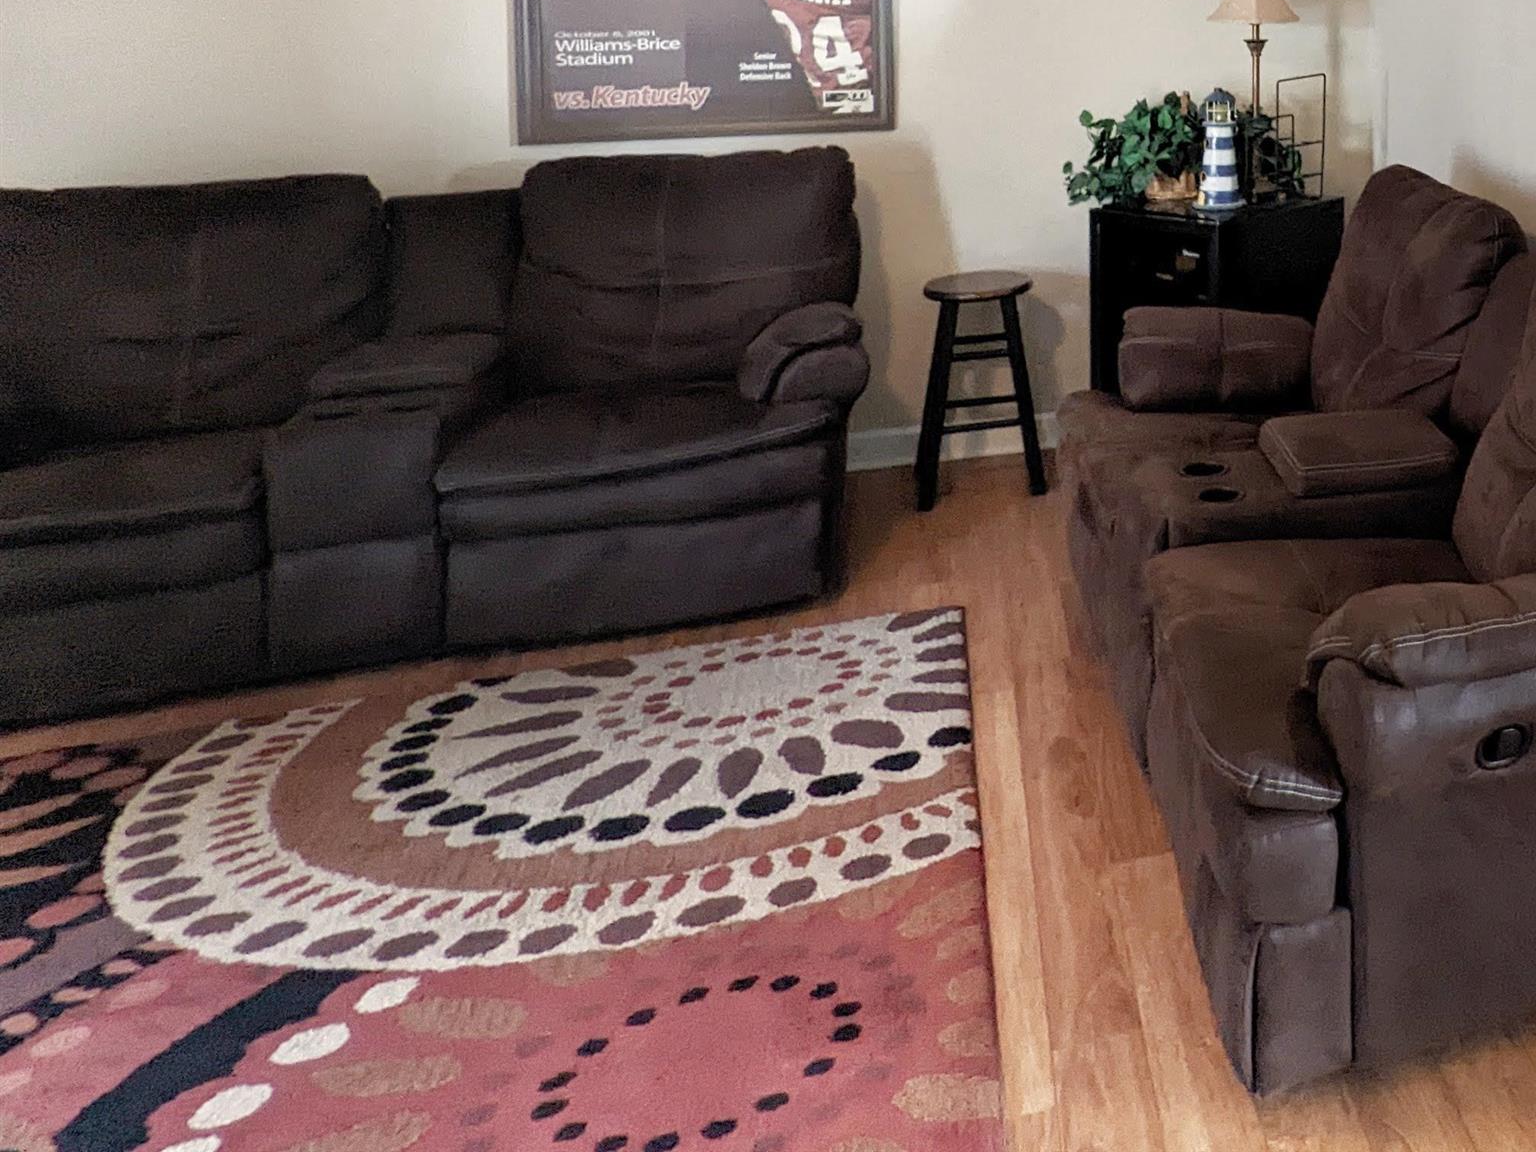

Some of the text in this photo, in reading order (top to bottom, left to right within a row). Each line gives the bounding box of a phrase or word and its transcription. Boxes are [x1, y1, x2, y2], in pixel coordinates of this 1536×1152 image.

[554, 30, 609, 39] October
[554, 36, 681, 52] Williams-Brice
[555, 52, 634, 67] Stadium
[768, 61, 792, 70] Brown
[774, 71, 792, 80] Back
[590, 81, 711, 111] Kentucky
